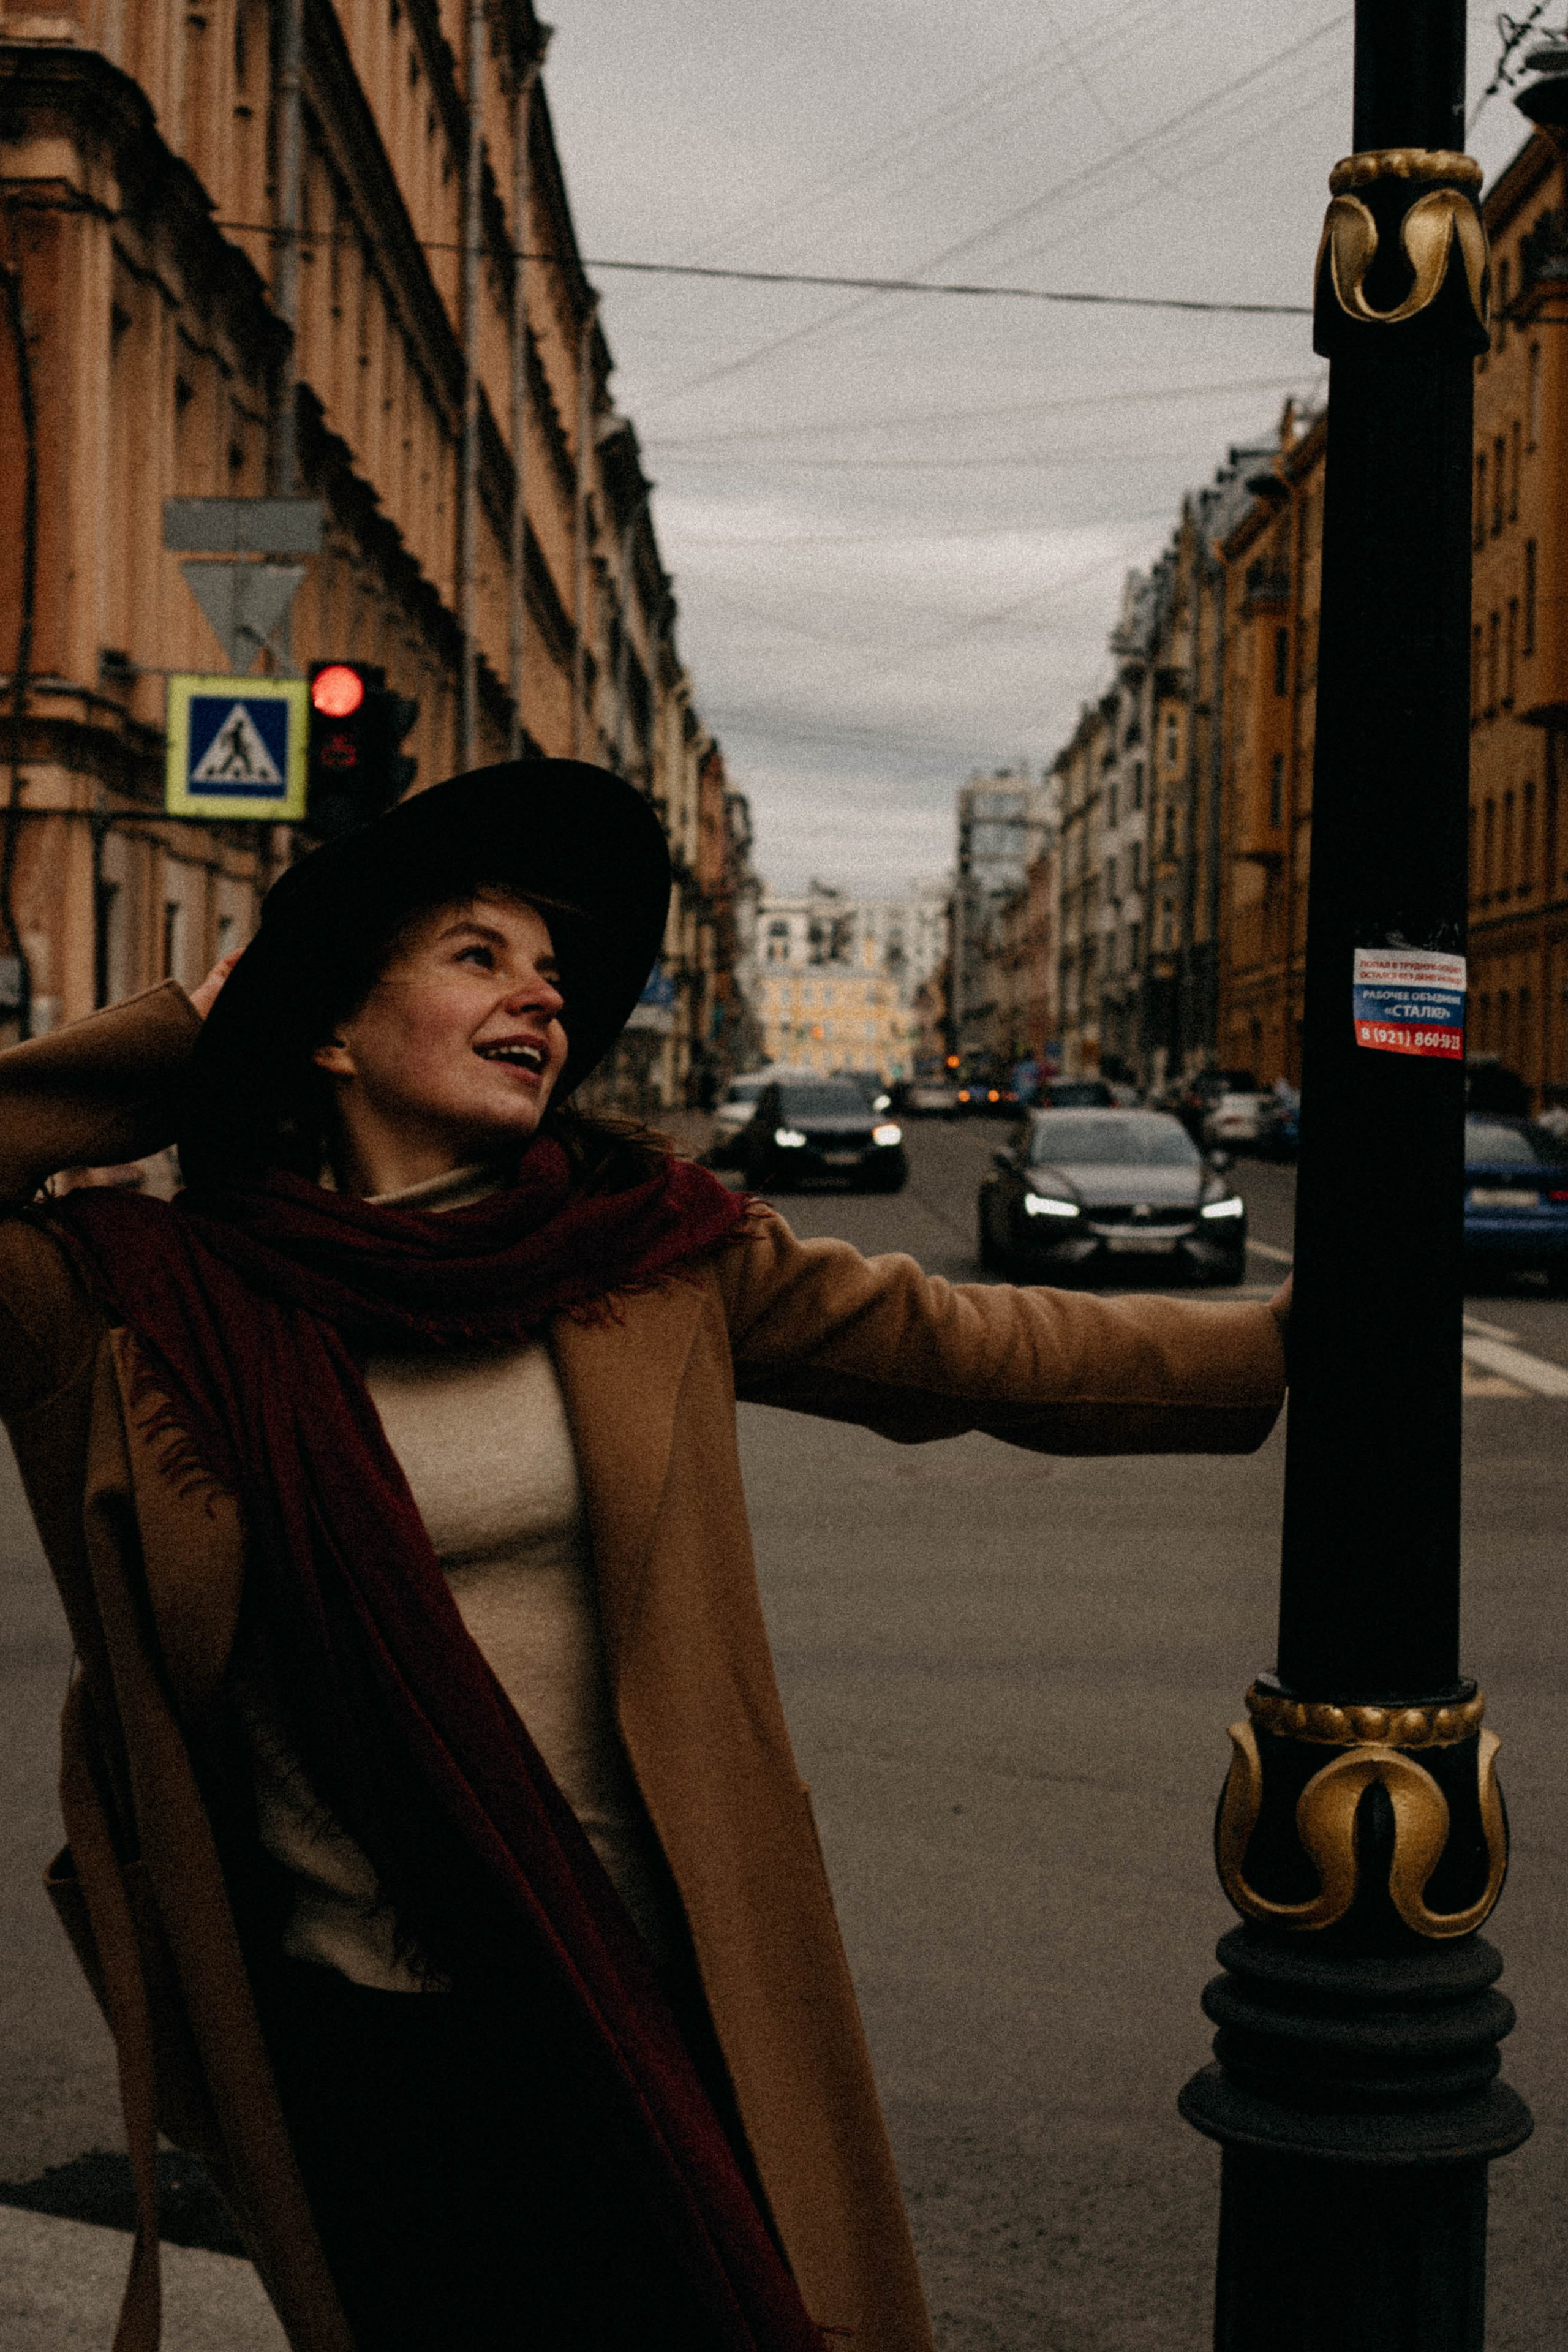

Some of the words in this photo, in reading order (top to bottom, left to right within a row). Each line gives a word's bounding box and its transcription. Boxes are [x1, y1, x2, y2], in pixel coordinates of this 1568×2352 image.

[1363, 990, 1409, 1000] РАБОЧЕЕ
[1361, 1027, 1371, 1040] 8
[1373, 1027, 1411, 1047] (921)
